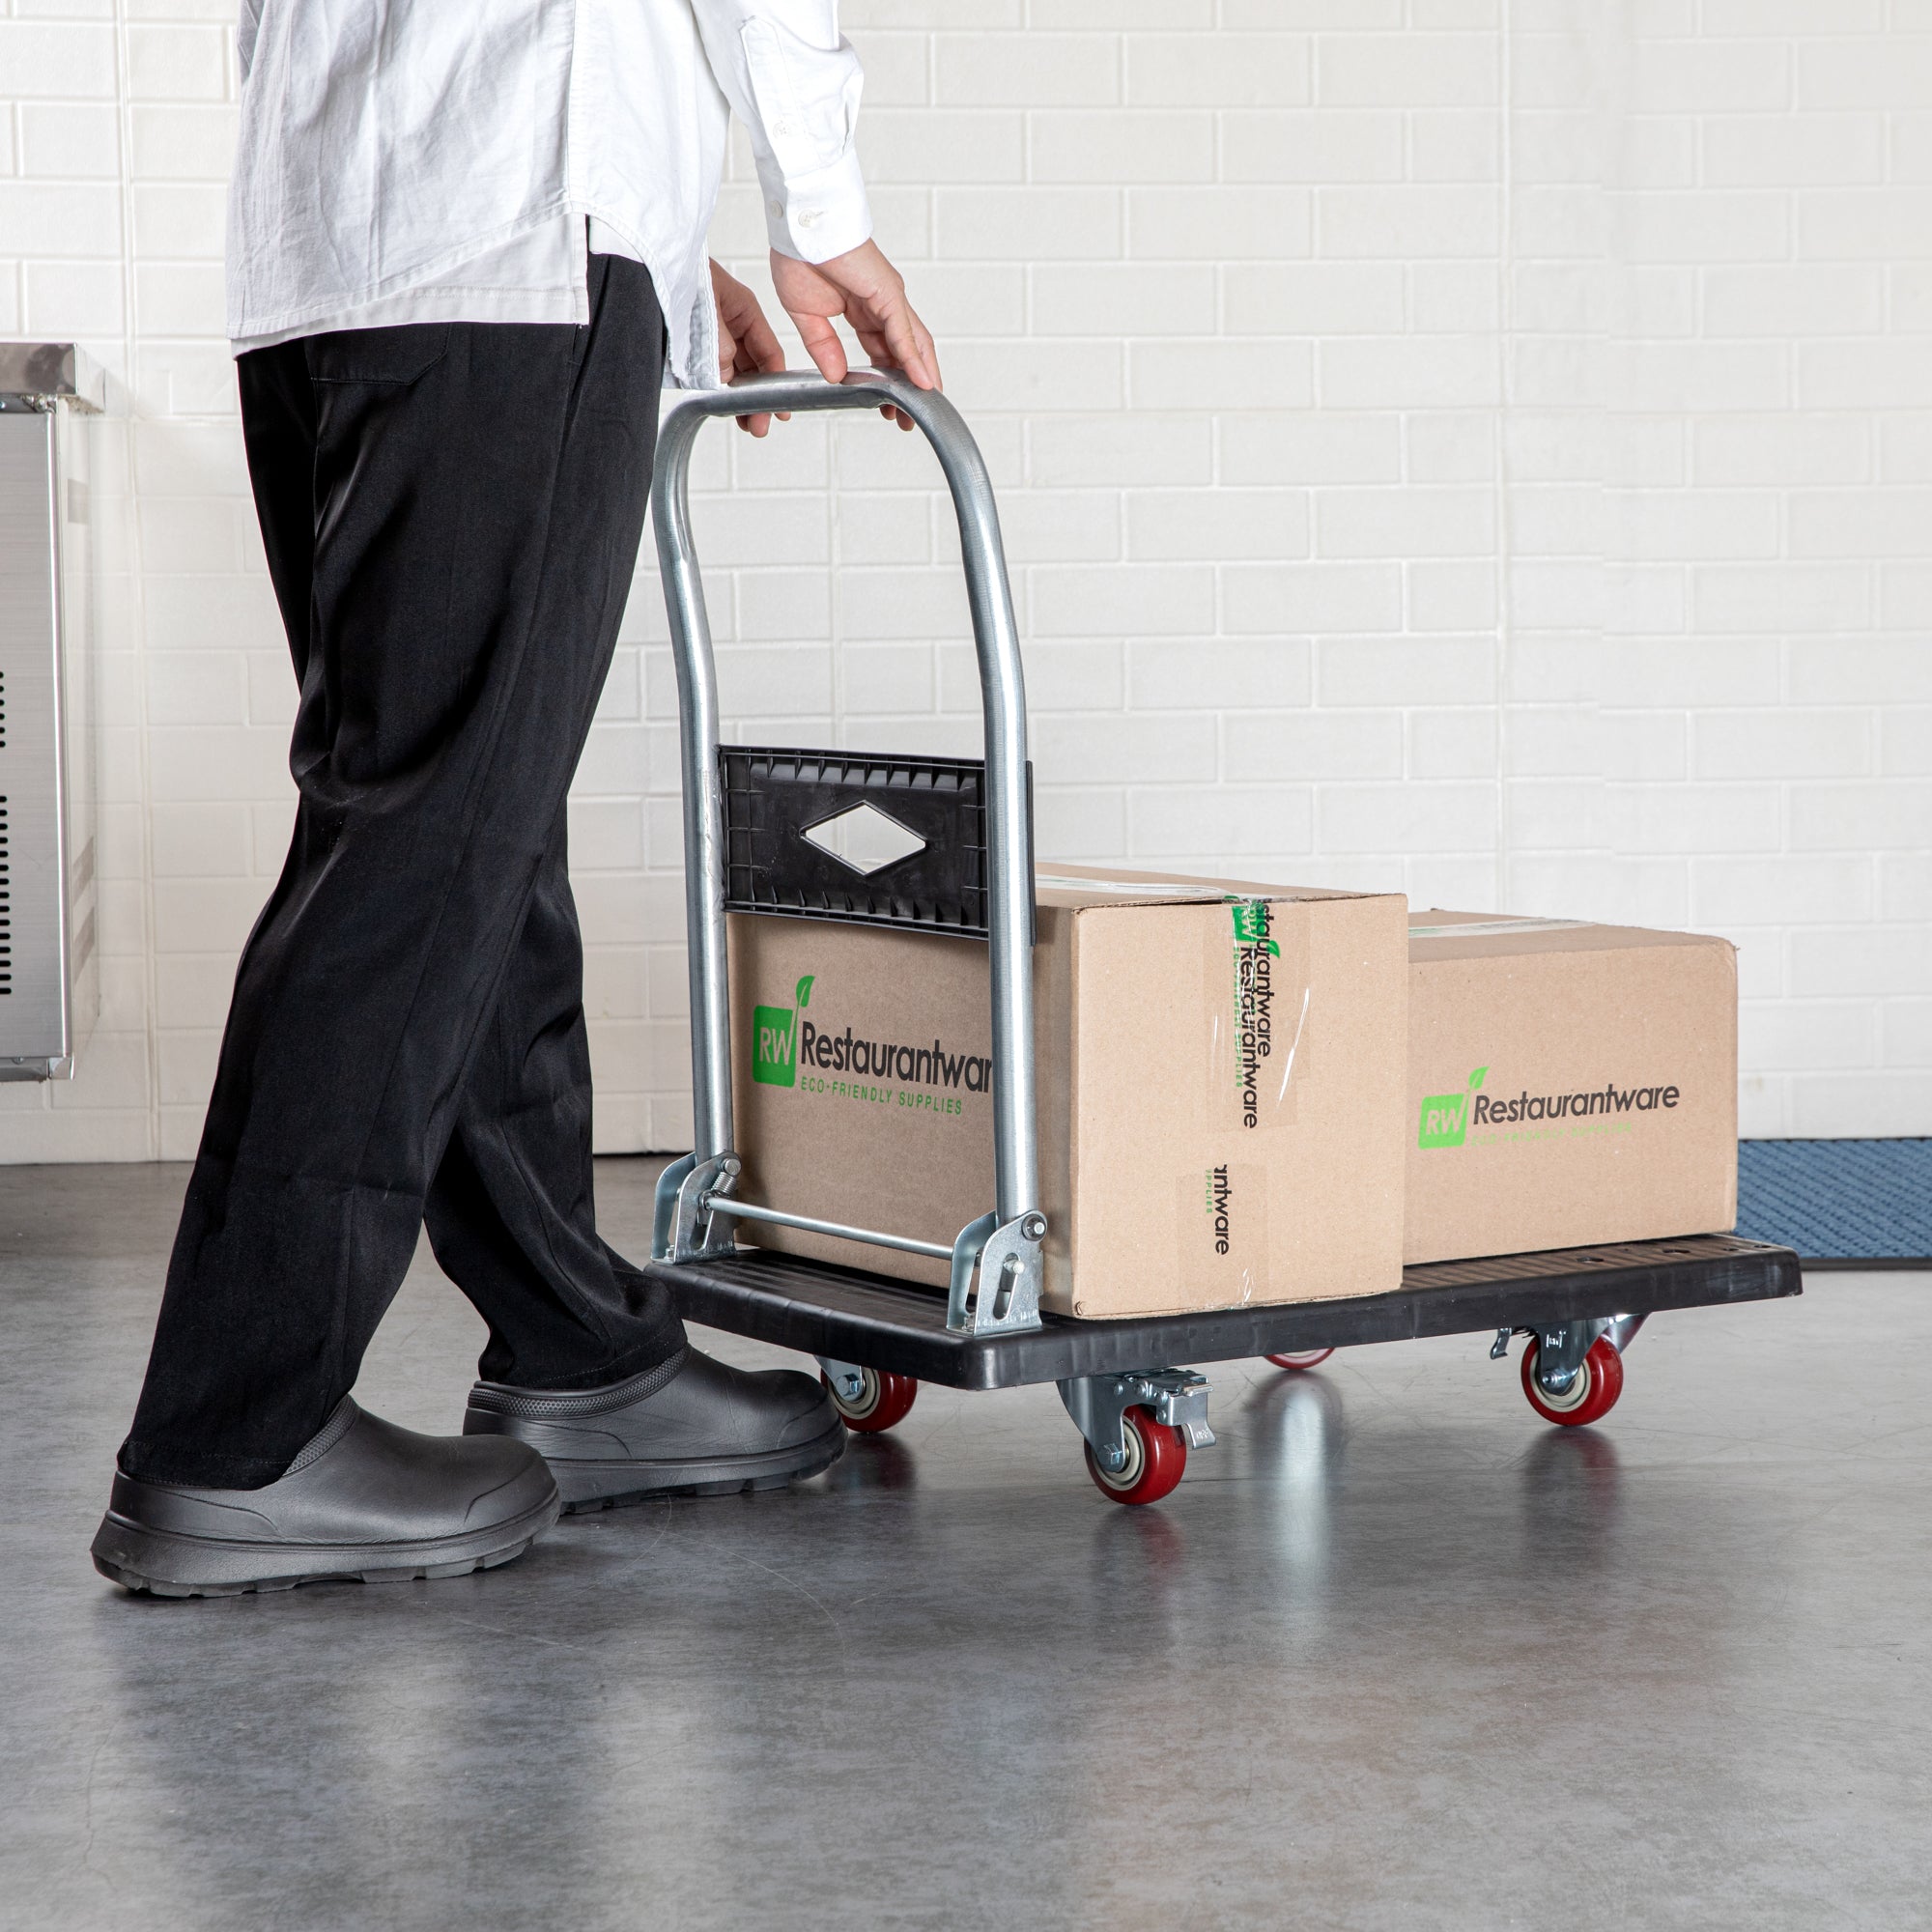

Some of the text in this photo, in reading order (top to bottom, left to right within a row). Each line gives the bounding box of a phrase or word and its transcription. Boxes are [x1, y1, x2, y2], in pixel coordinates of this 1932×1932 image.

[801, 1021, 992, 1094] Restaurantwar
[1240, 947, 1261, 1128] Restaurantware
[801, 1076, 962, 1116] ECO-FRIENDLY SUPPLIES
[1473, 1083, 1680, 1125] Restaurantware
[1425, 1106, 1467, 1137] RW
